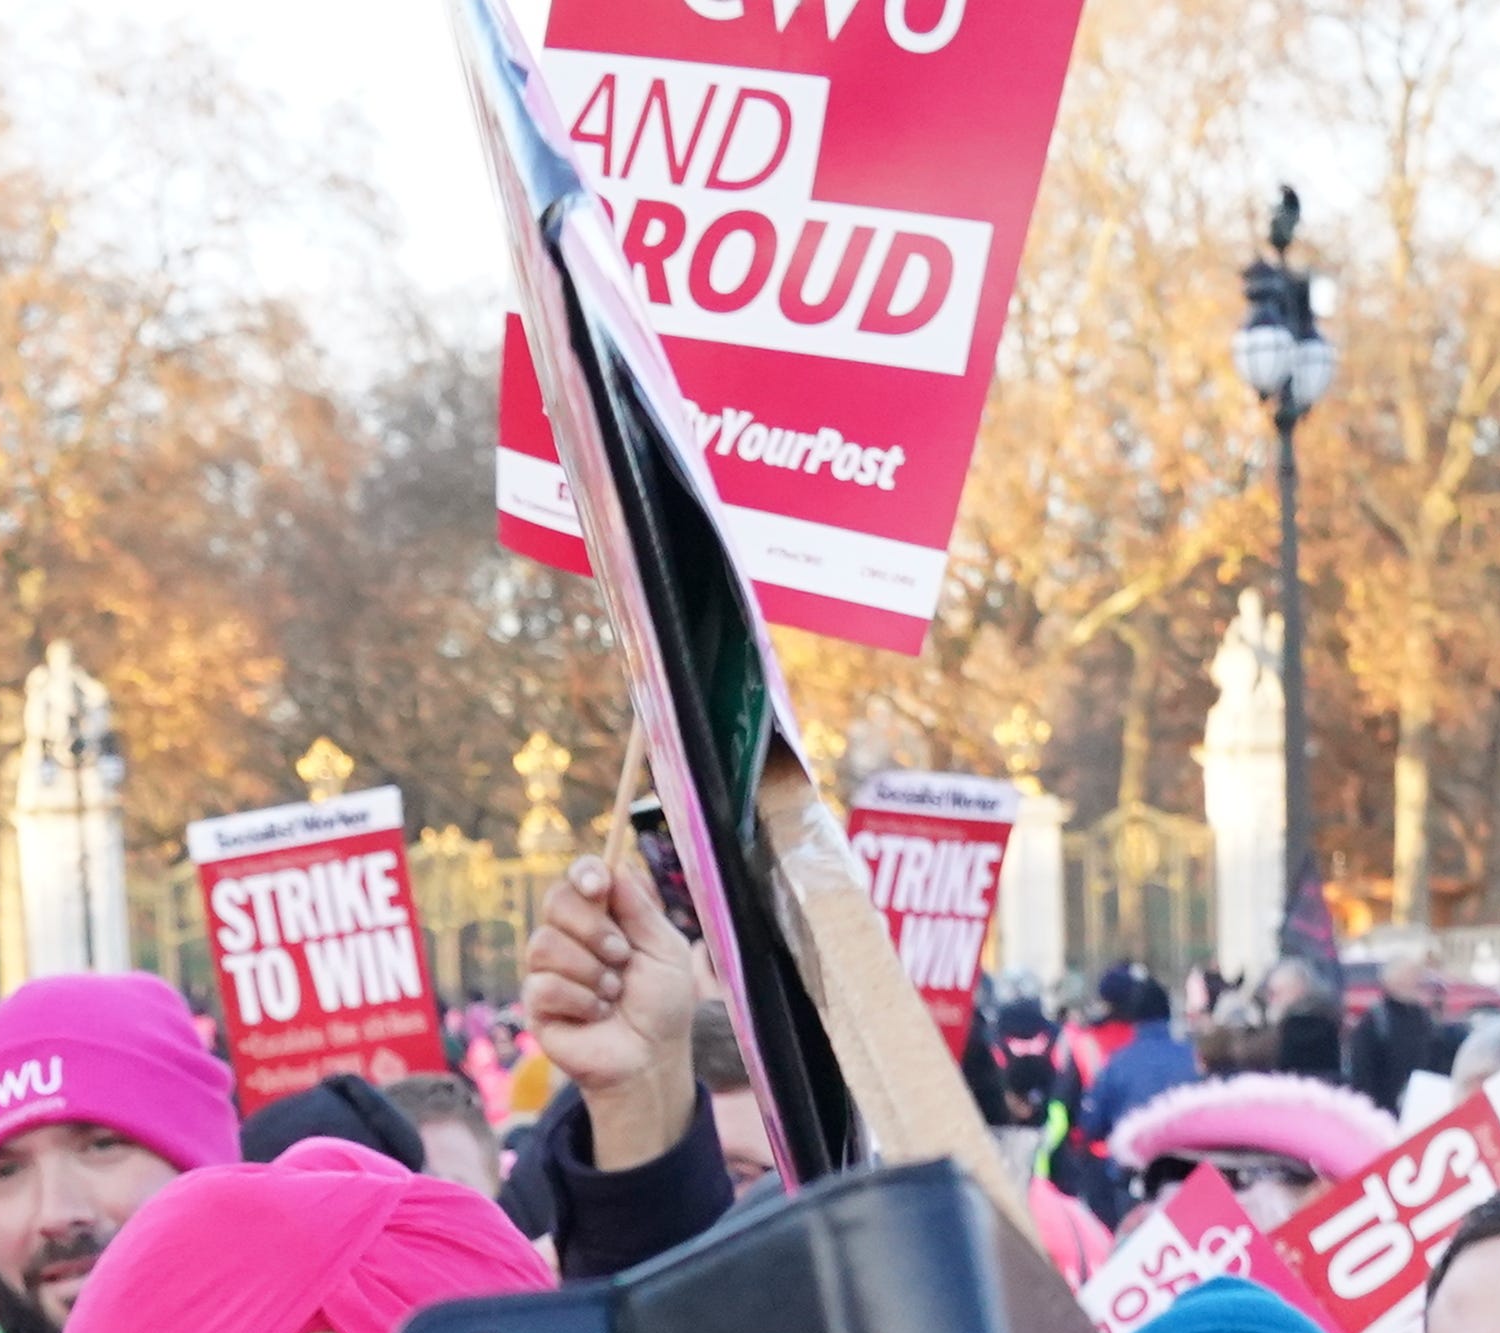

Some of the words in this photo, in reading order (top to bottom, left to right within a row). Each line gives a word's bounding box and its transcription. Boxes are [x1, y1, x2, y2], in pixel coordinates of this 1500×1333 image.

[570, 73, 792, 191] AND
[601, 195, 954, 337] ROUD
[211, 850, 409, 953] STRIKE
[221, 945, 301, 1026] TO
[303, 924, 422, 1014] WIN
[1308, 1174, 1416, 1300] TO
